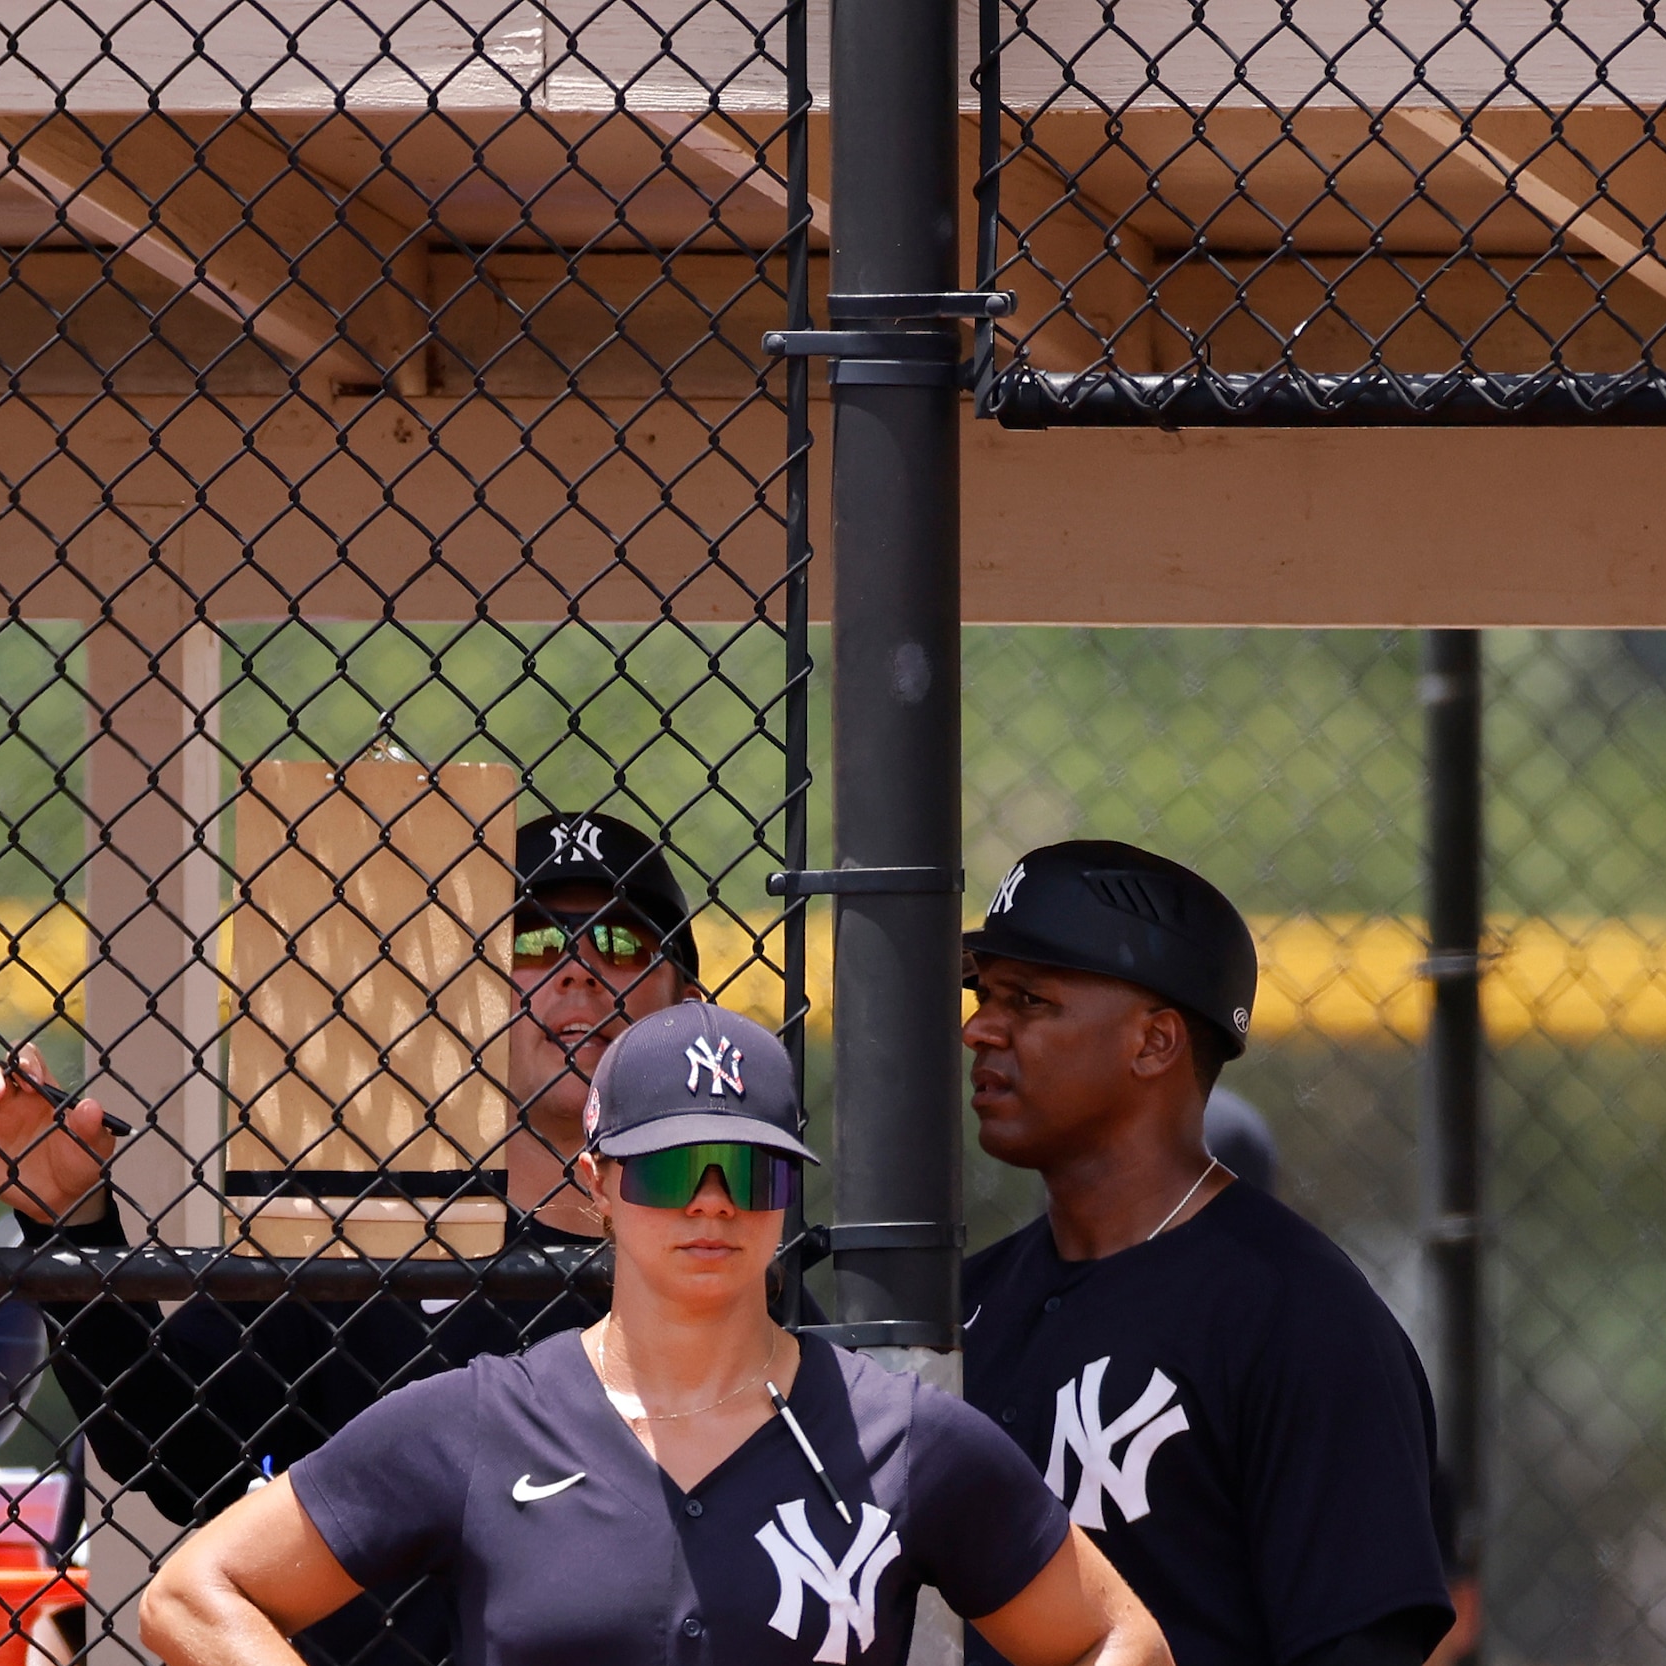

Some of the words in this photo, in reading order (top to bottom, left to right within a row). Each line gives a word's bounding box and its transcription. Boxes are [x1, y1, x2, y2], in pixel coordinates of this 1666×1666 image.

[549, 819, 604, 864] NY
[684, 1035, 746, 1097] NY
[1042, 1356, 1190, 1532] NY
[754, 1498, 902, 1666] NY
